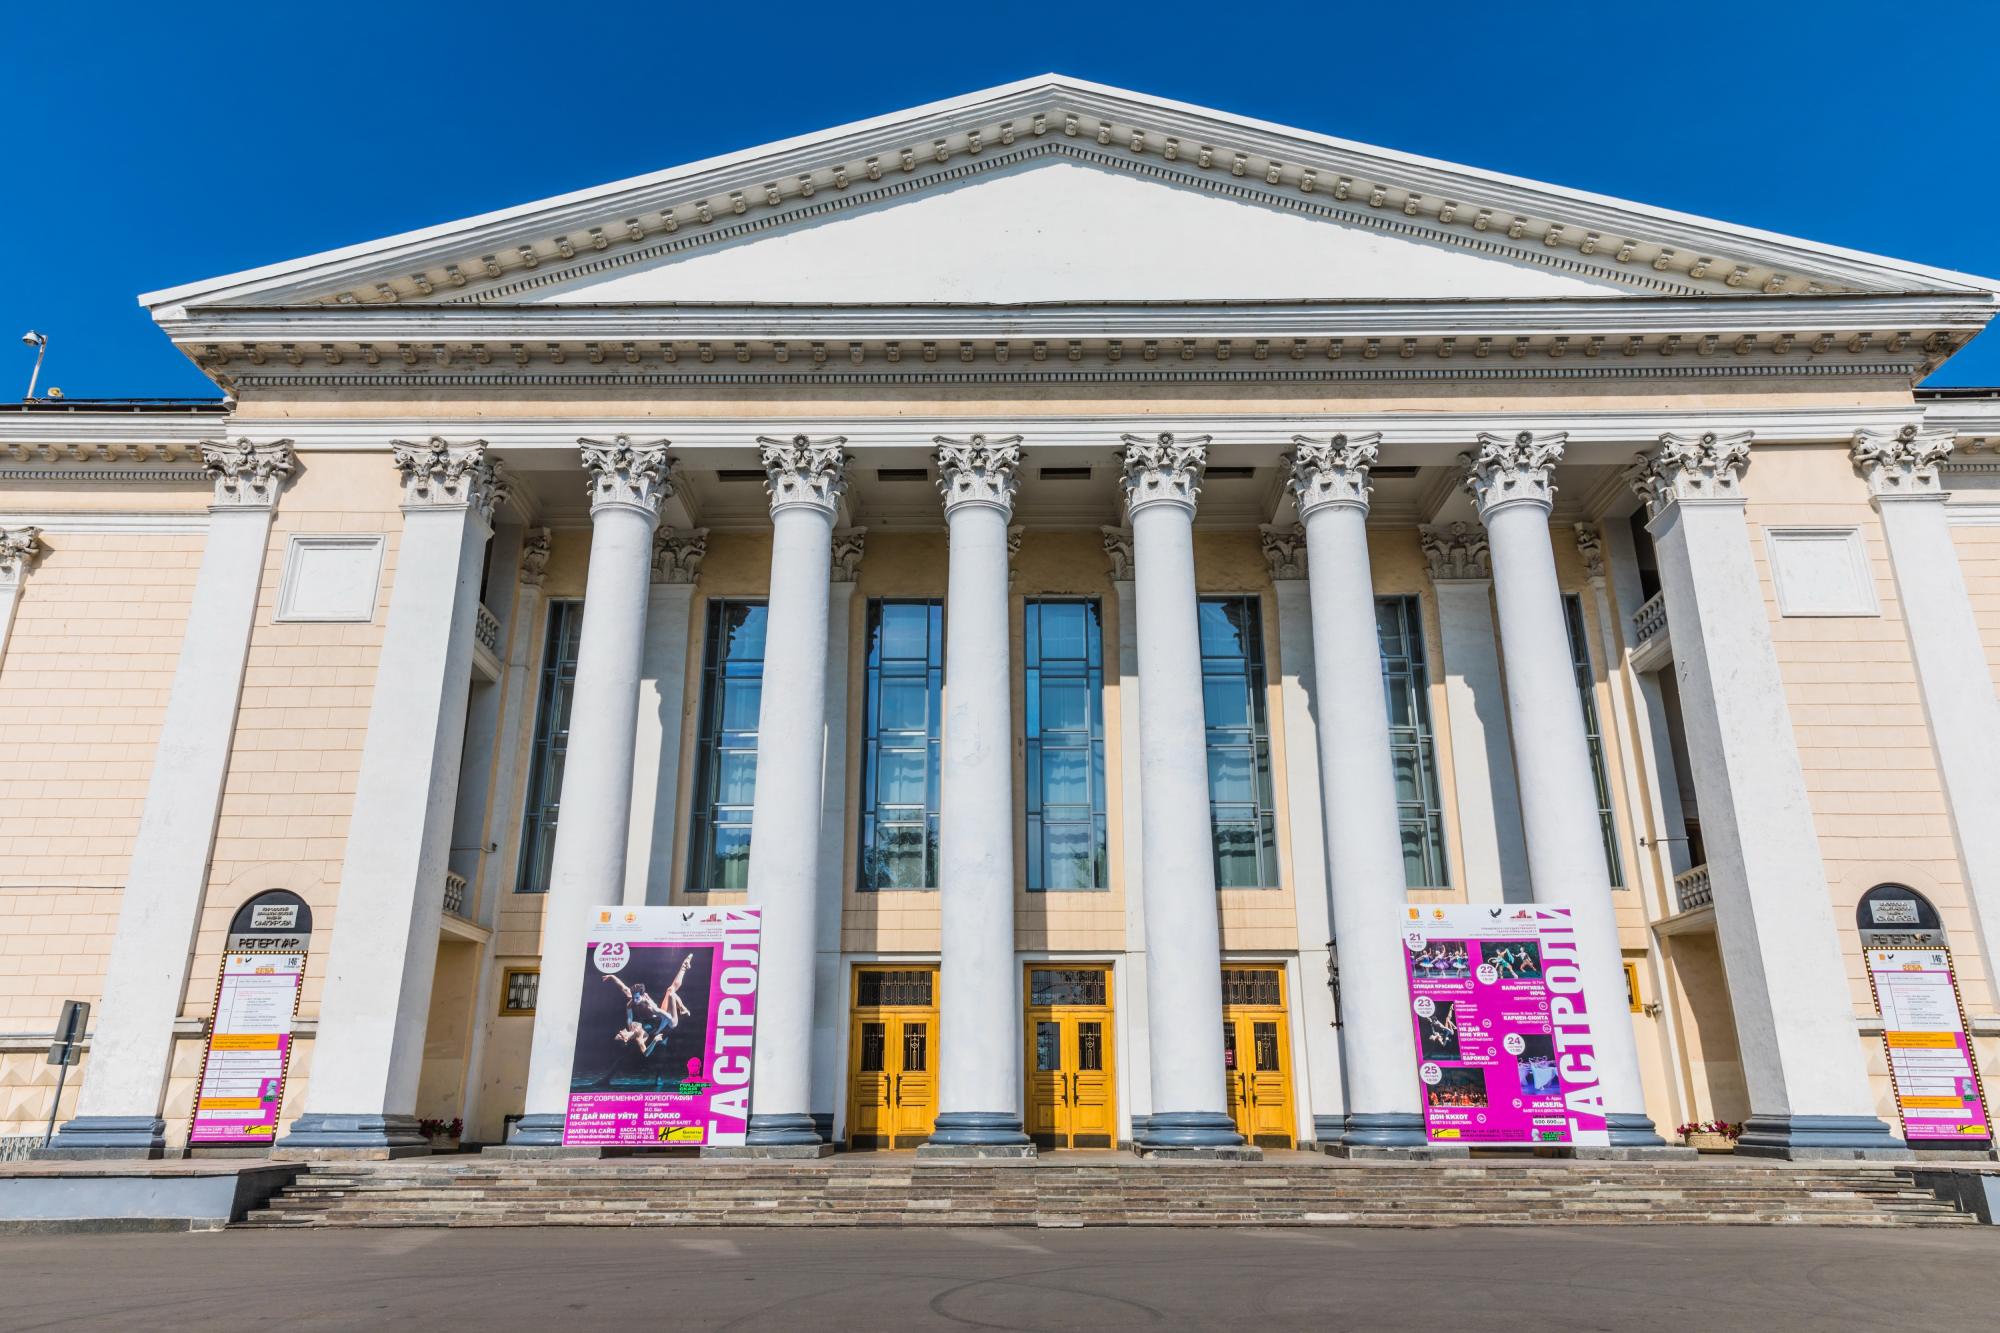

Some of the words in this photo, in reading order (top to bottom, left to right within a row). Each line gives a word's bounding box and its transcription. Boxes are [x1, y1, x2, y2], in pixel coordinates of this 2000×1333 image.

[601, 943, 624, 956] 23
[1480, 966, 1493, 974] 22
[1417, 999, 1431, 1007] 23
[708, 907, 761, 1146] ГАСТРОЛИ
[1535, 906, 1610, 1146] ГАСТРОЛИ
[1507, 1036, 1521, 1044] 24
[1424, 1066, 1438, 1075] 25
[582, 1112, 597, 1120] ДАЙ
